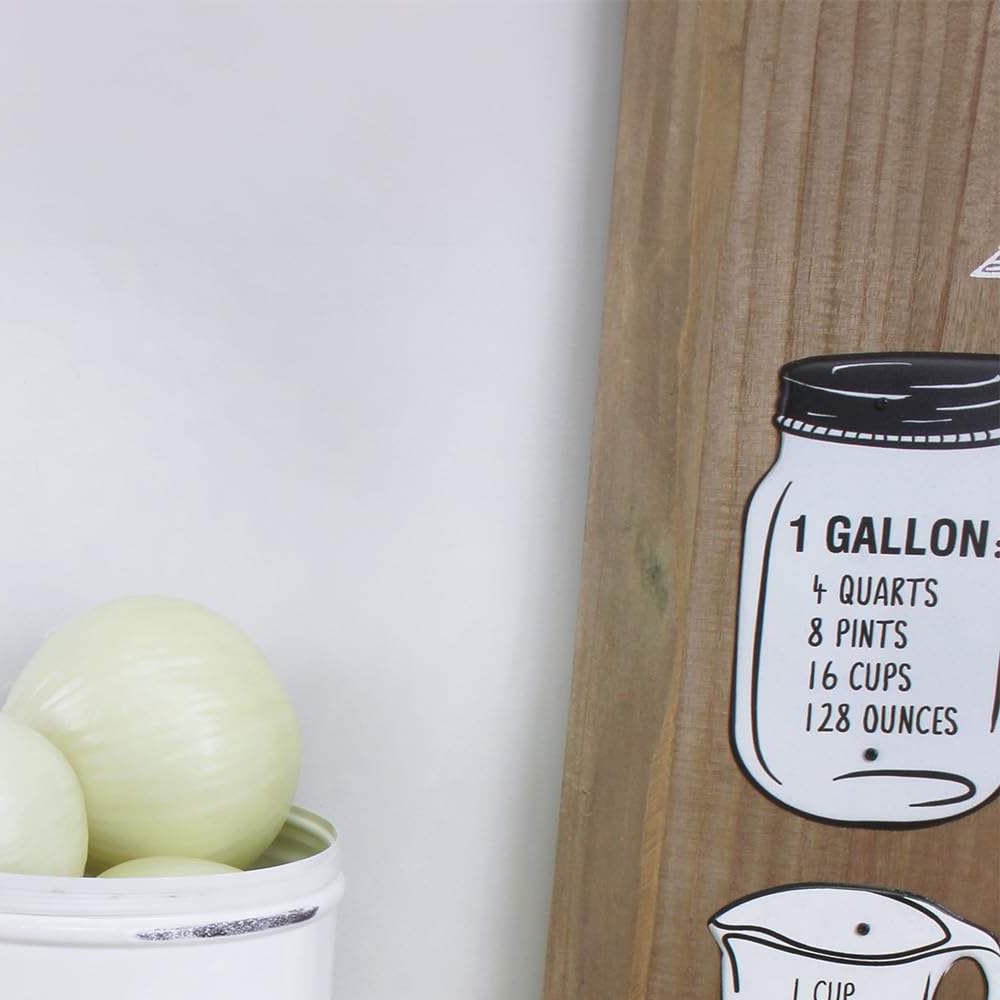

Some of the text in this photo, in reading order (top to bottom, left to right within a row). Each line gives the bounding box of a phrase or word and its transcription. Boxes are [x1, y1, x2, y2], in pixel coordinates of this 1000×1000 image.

[789, 514, 807, 553] 1
[813, 574, 939, 608] 4 QUARTS
[807, 617, 908, 650] 8 PINTS
[809, 660, 912, 692] 16 CUPS
[805, 702, 959, 736] 128 OUNCES
